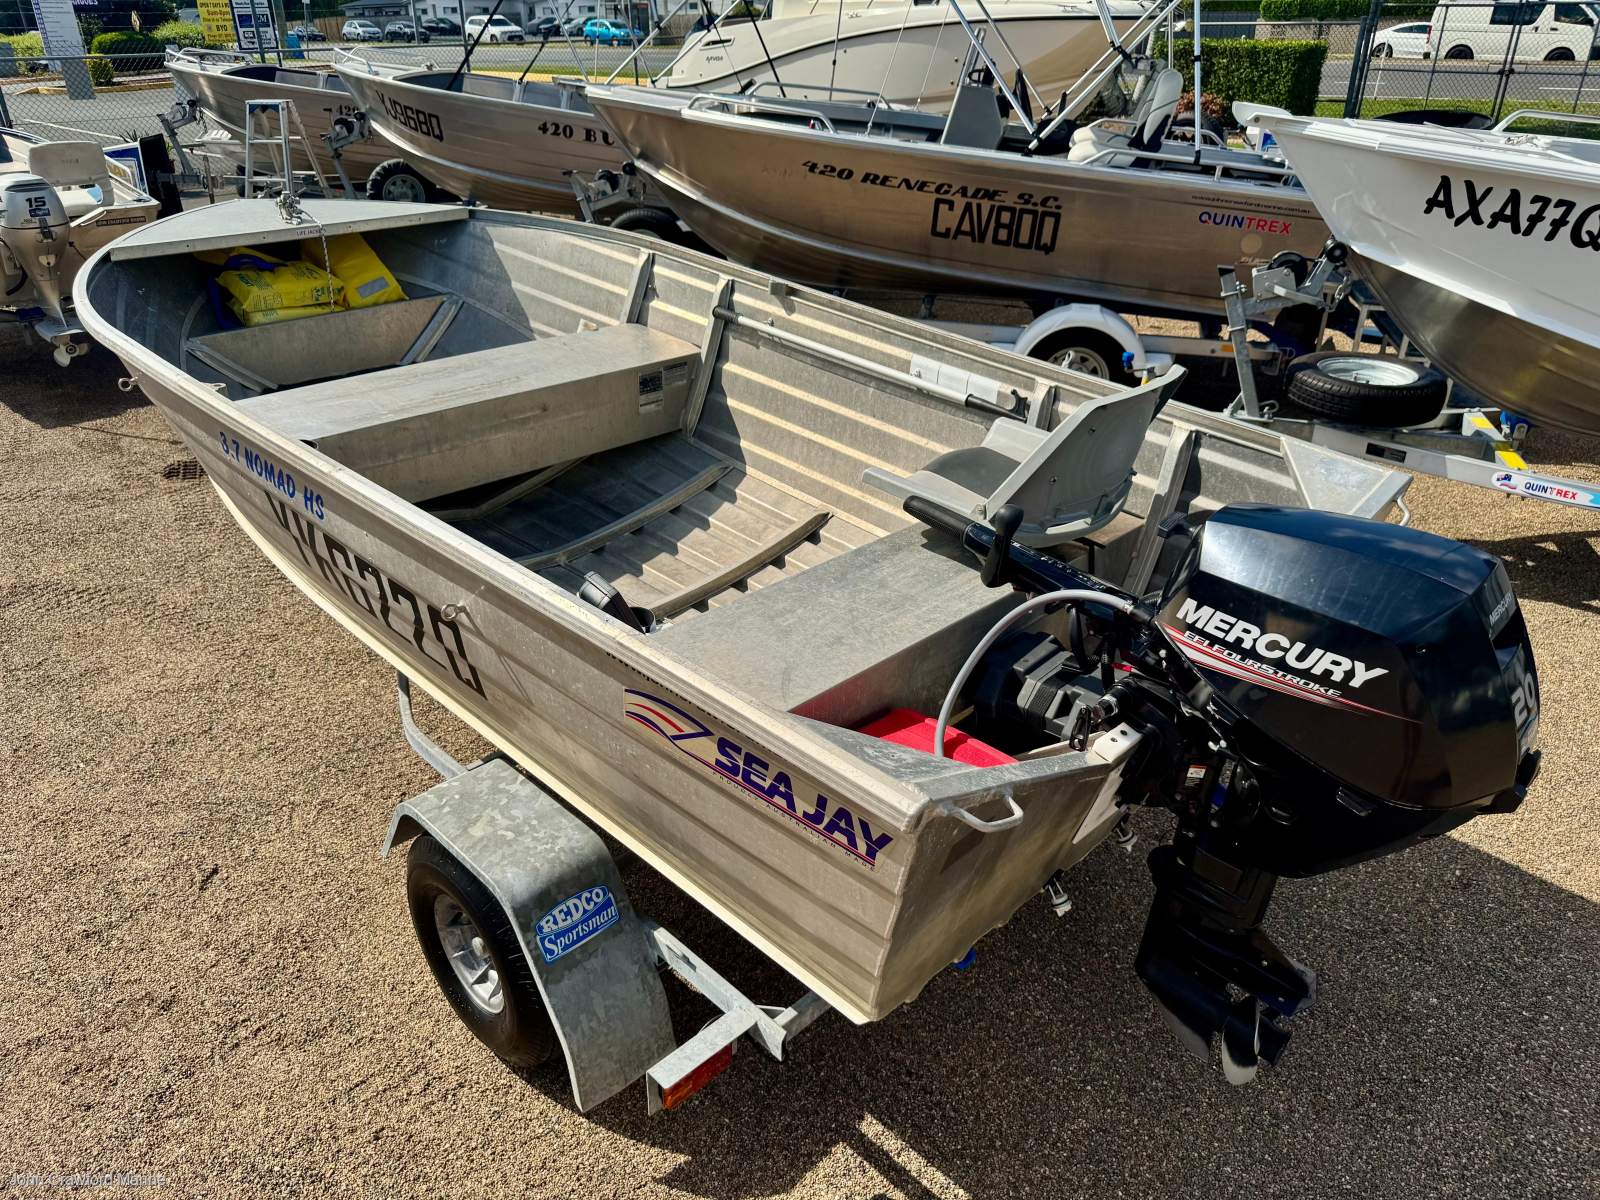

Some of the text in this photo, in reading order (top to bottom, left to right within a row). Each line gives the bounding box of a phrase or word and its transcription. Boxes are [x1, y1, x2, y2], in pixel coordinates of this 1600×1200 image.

[376, 90, 444, 142] YJ968Q
[538, 121, 574, 139] 420
[25, 196, 47, 208] 15
[801, 160, 1063, 210] 420 RENEGADE S.C.
[930, 197, 1062, 256] CAV80Q
[1198, 211, 1292, 235] QUINTREX
[1423, 175, 1600, 252] AXA77Q
[219, 431, 325, 520] 3.7 NOMAD HS
[1524, 481, 1579, 501] QUINTREX
[264, 490, 488, 700] YK622Q
[1175, 597, 1390, 689] MERCURY
[1212, 643, 1343, 698] FOURSTROKE
[1511, 672, 1536, 728] 20
[714, 737, 894, 864] SEA JAY
[767, 803, 836, 848] AUSTRALIAN
[844, 851, 876, 871] MADE
[541, 888, 604, 933] REDCO
[544, 905, 618, 959] Sportsman
